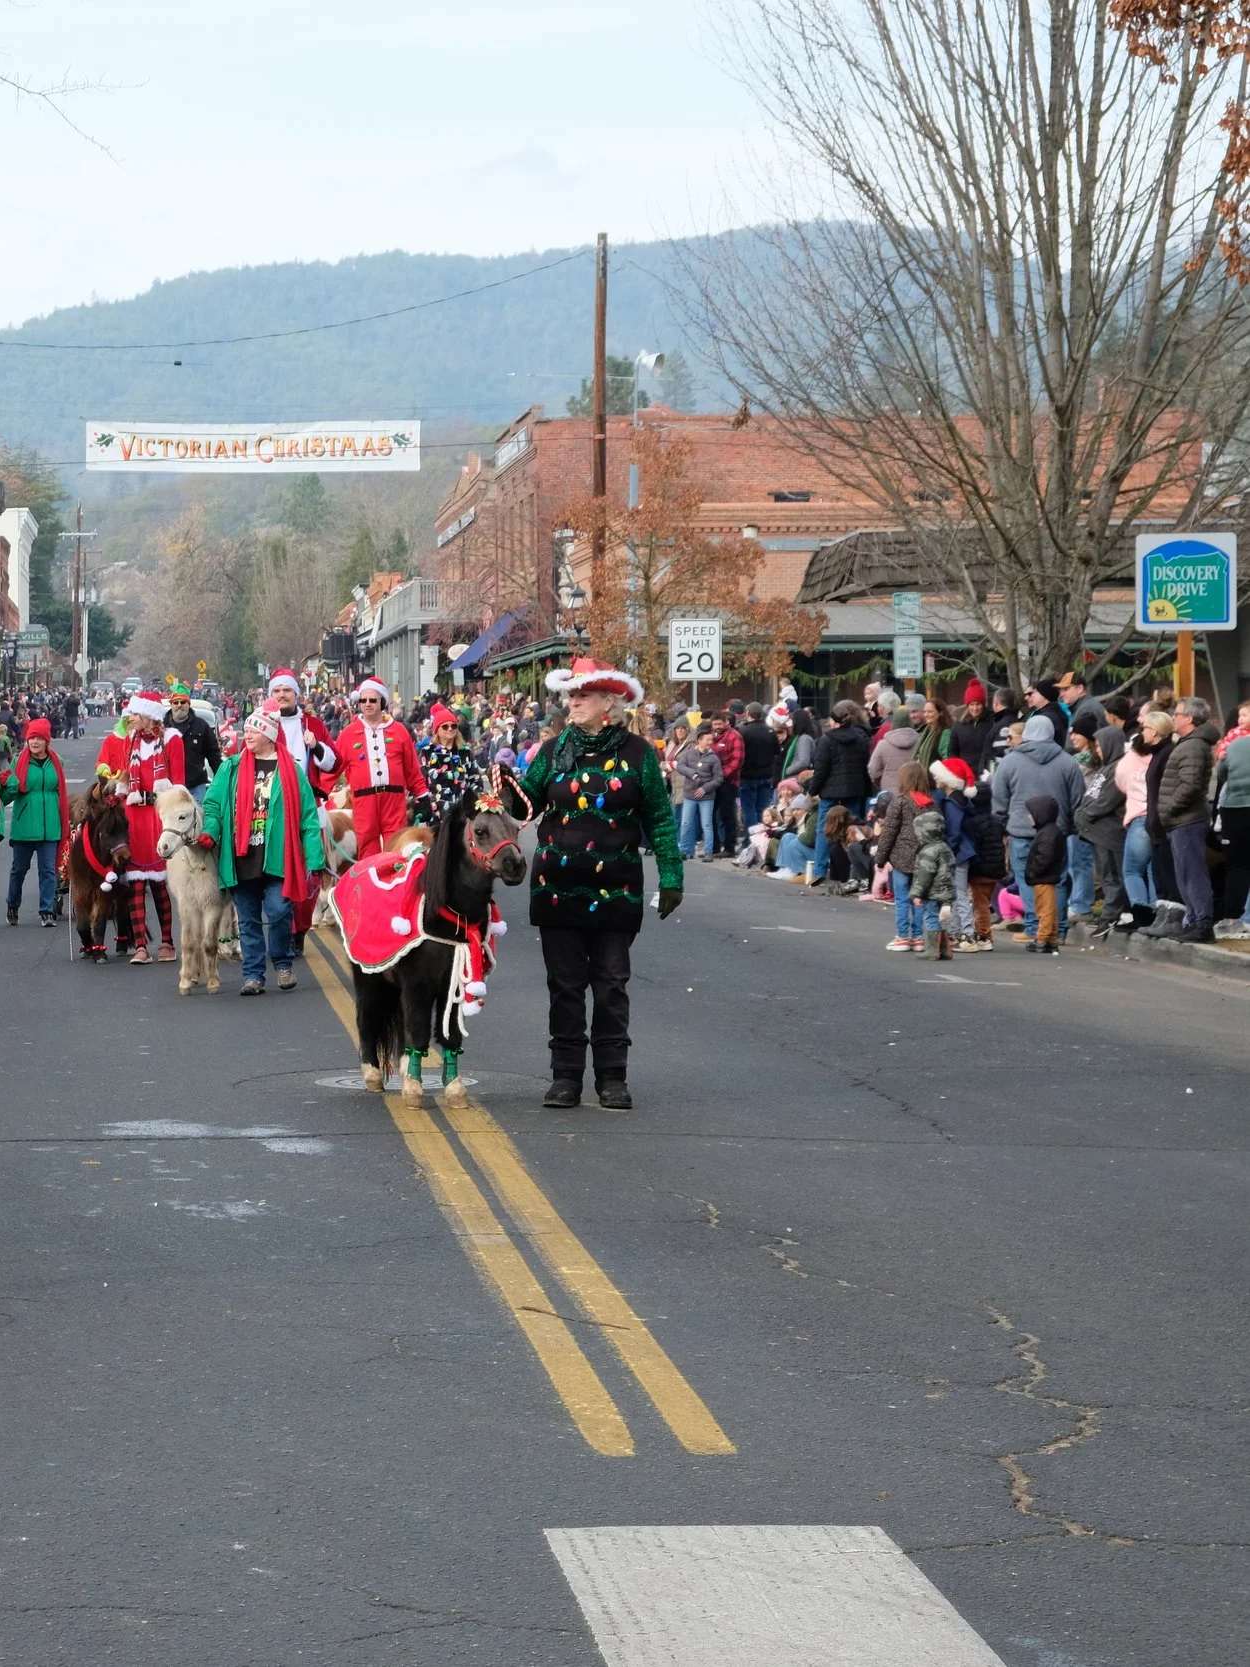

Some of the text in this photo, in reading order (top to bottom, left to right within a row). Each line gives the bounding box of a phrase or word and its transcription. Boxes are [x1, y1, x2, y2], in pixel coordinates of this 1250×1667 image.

[118, 433, 393, 463] VICTORIAN CHRISTMAS
[1153, 565, 1220, 581] DISCOVERY
[1167, 582, 1208, 597] DRIVE
[675, 626, 716, 636] SPEED
[679, 639, 712, 649] LIMIT
[676, 652, 714, 673] 20
